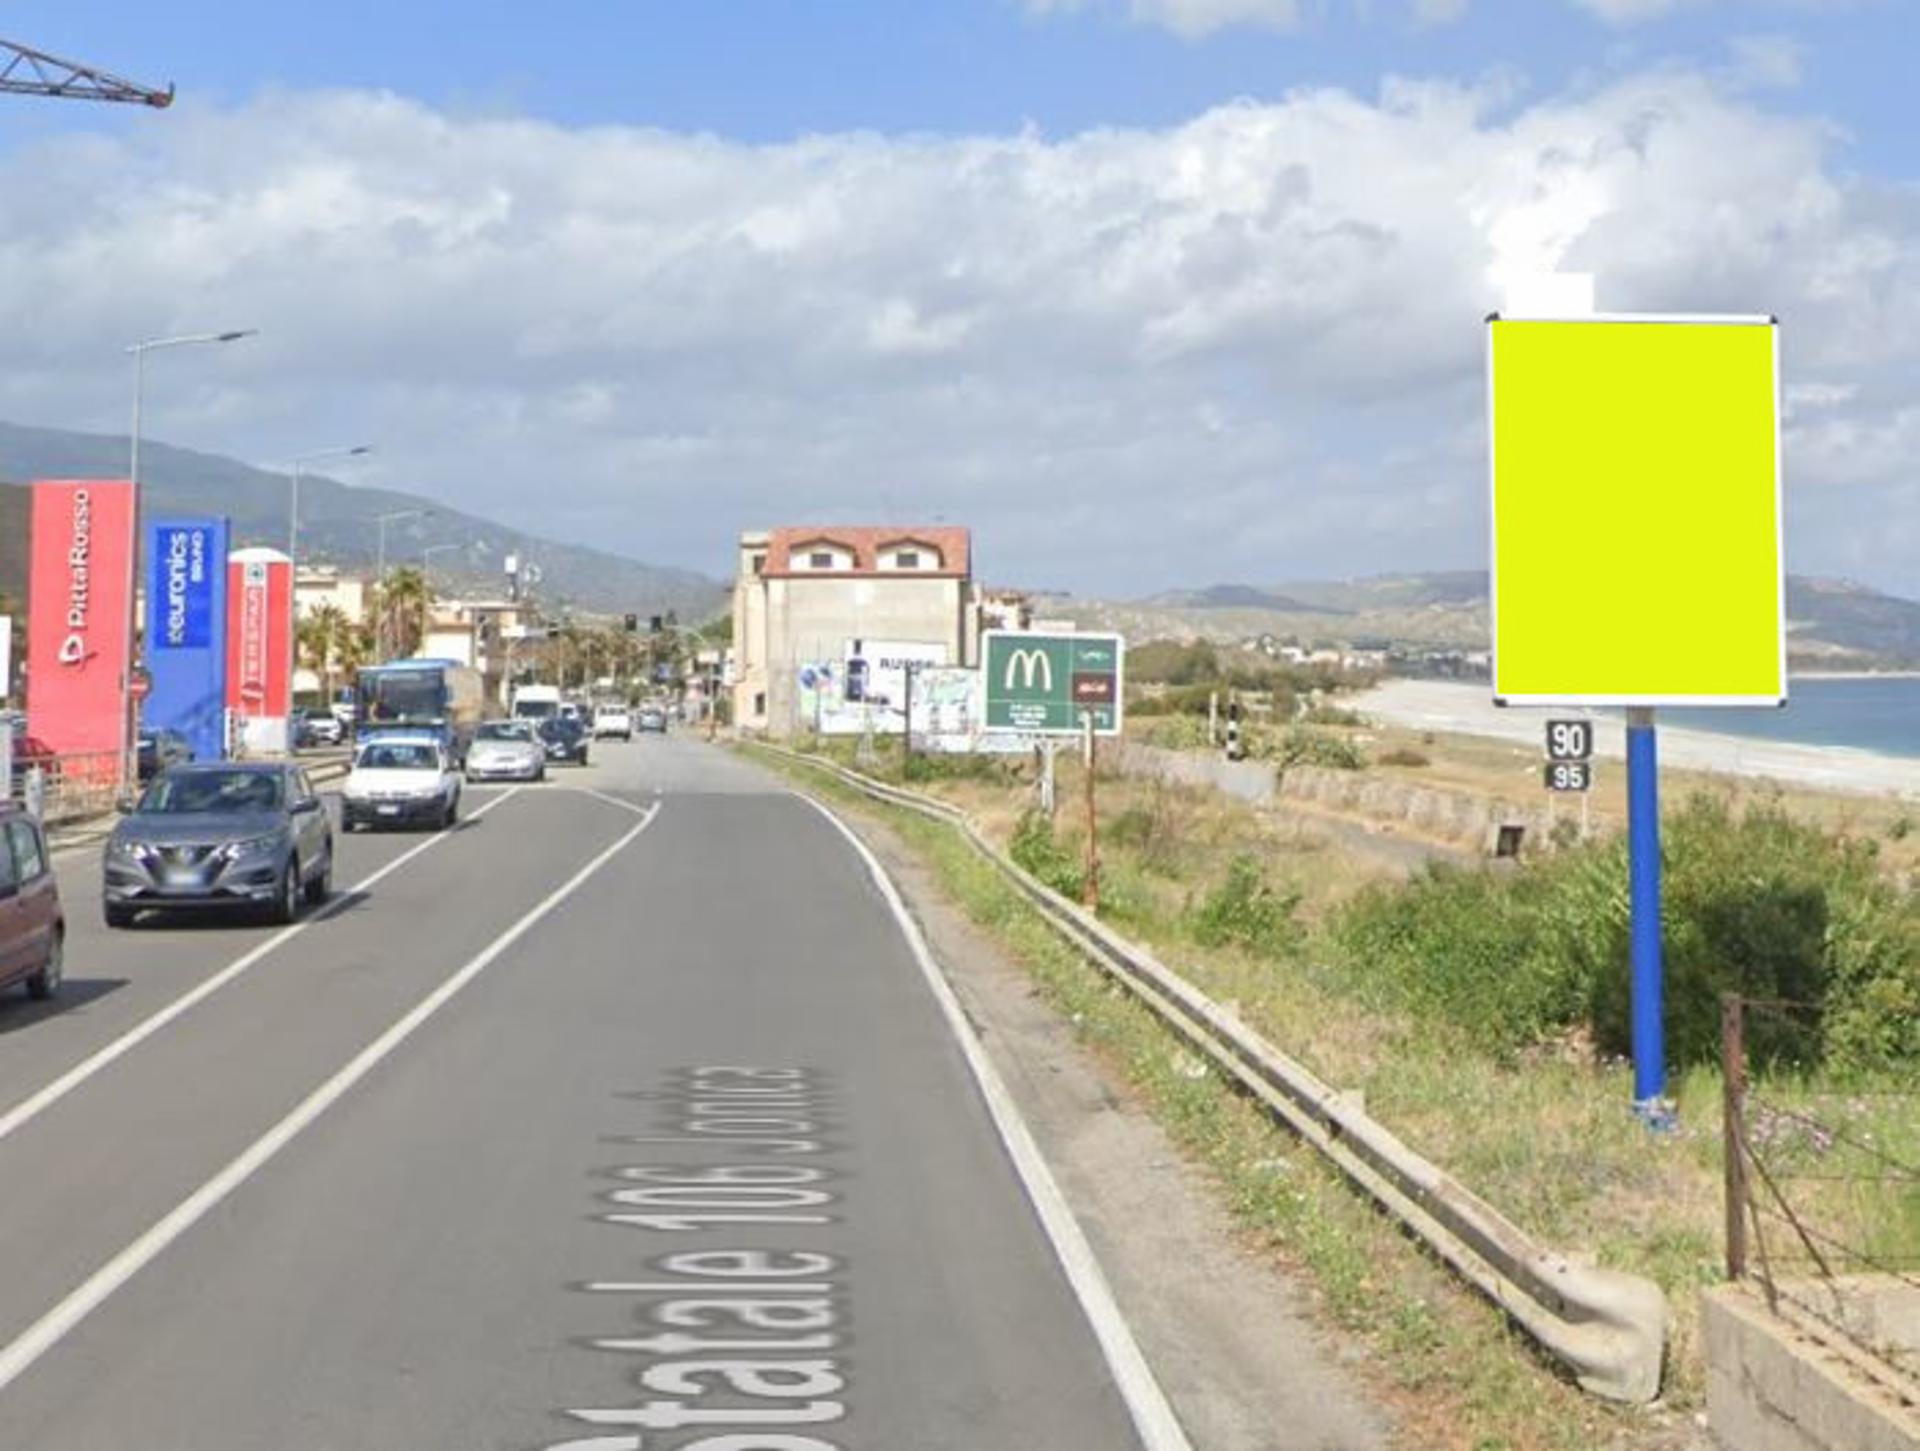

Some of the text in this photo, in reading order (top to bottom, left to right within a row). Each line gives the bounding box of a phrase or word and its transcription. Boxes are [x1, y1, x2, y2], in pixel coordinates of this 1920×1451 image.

[68, 490, 89, 627] PittaRosso
[166, 532, 188, 629] euronics
[1552, 723, 1585, 756] 90
[1554, 766, 1584, 788] 95
